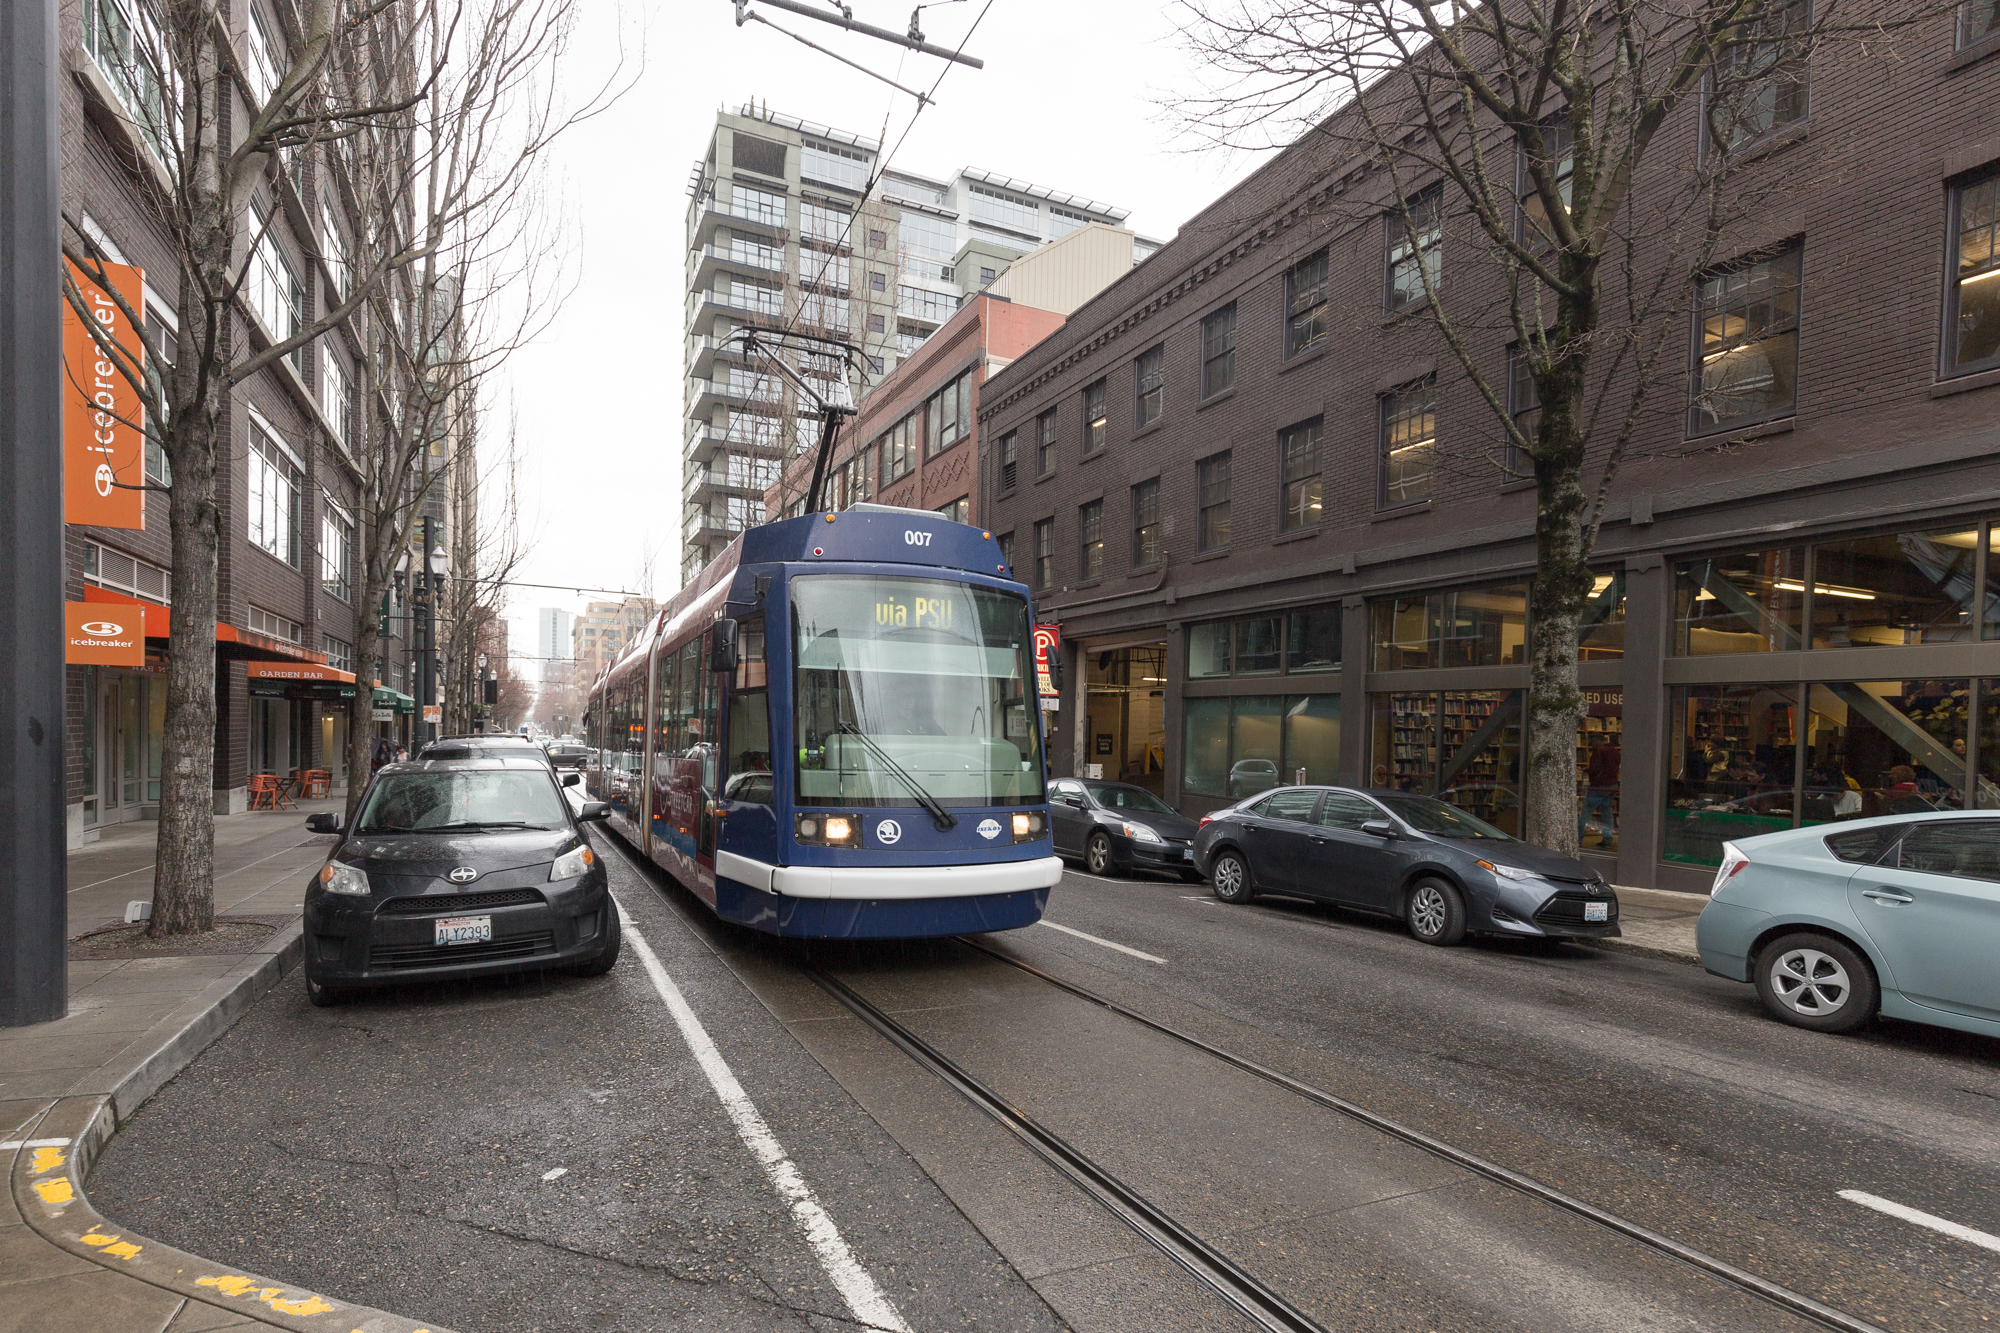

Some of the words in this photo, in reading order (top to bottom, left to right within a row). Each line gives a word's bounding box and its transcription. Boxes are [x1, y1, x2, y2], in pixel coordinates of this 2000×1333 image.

[904, 530, 933, 547] 007
[876, 596, 907, 627] via
[915, 597, 952, 630] PSU
[70, 638, 132, 647] icebreaker
[1036, 635, 1049, 656] P
[259, 670, 300, 678] GARDEN
[434, 706, 439, 714] 2
[438, 924, 490, 942] ALY2393
